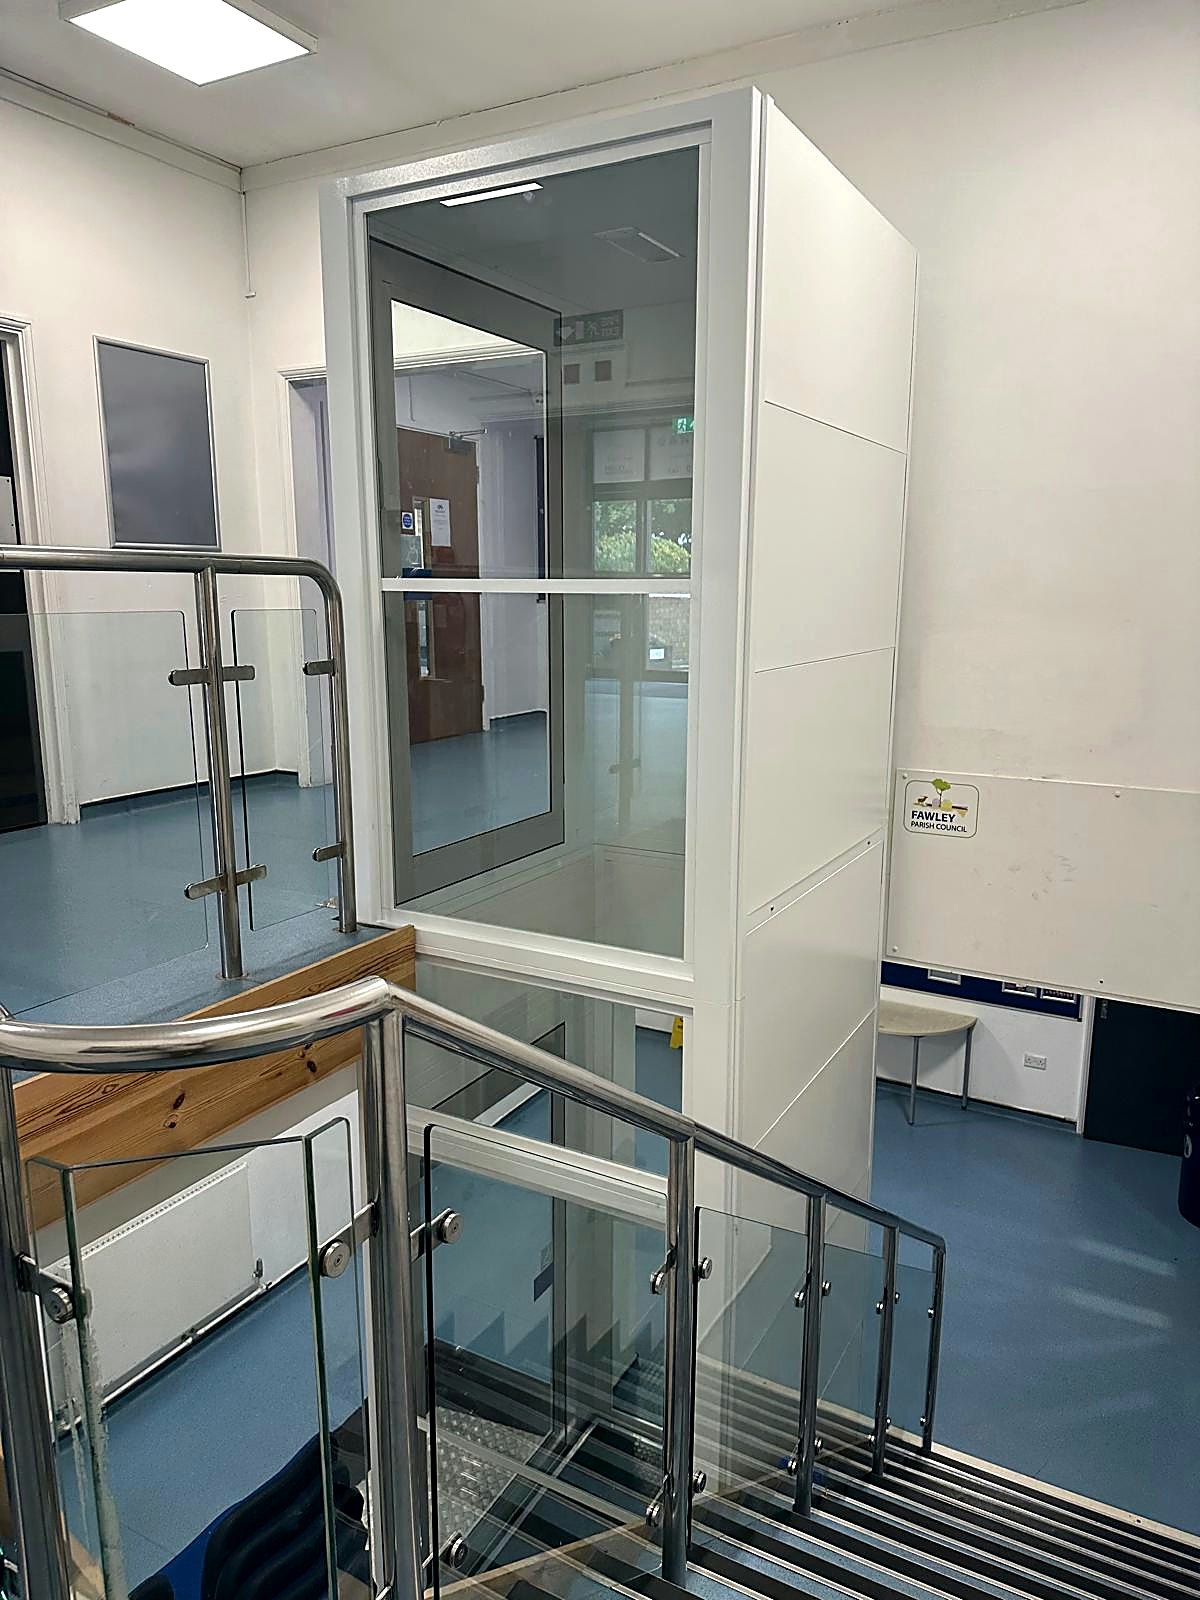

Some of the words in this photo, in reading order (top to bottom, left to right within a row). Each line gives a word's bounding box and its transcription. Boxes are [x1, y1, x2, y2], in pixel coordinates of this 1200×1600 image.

[912, 811, 956, 823] FAWLEY
[911, 820, 935, 830] PARISH
[936, 823, 968, 833] COUNCIL
